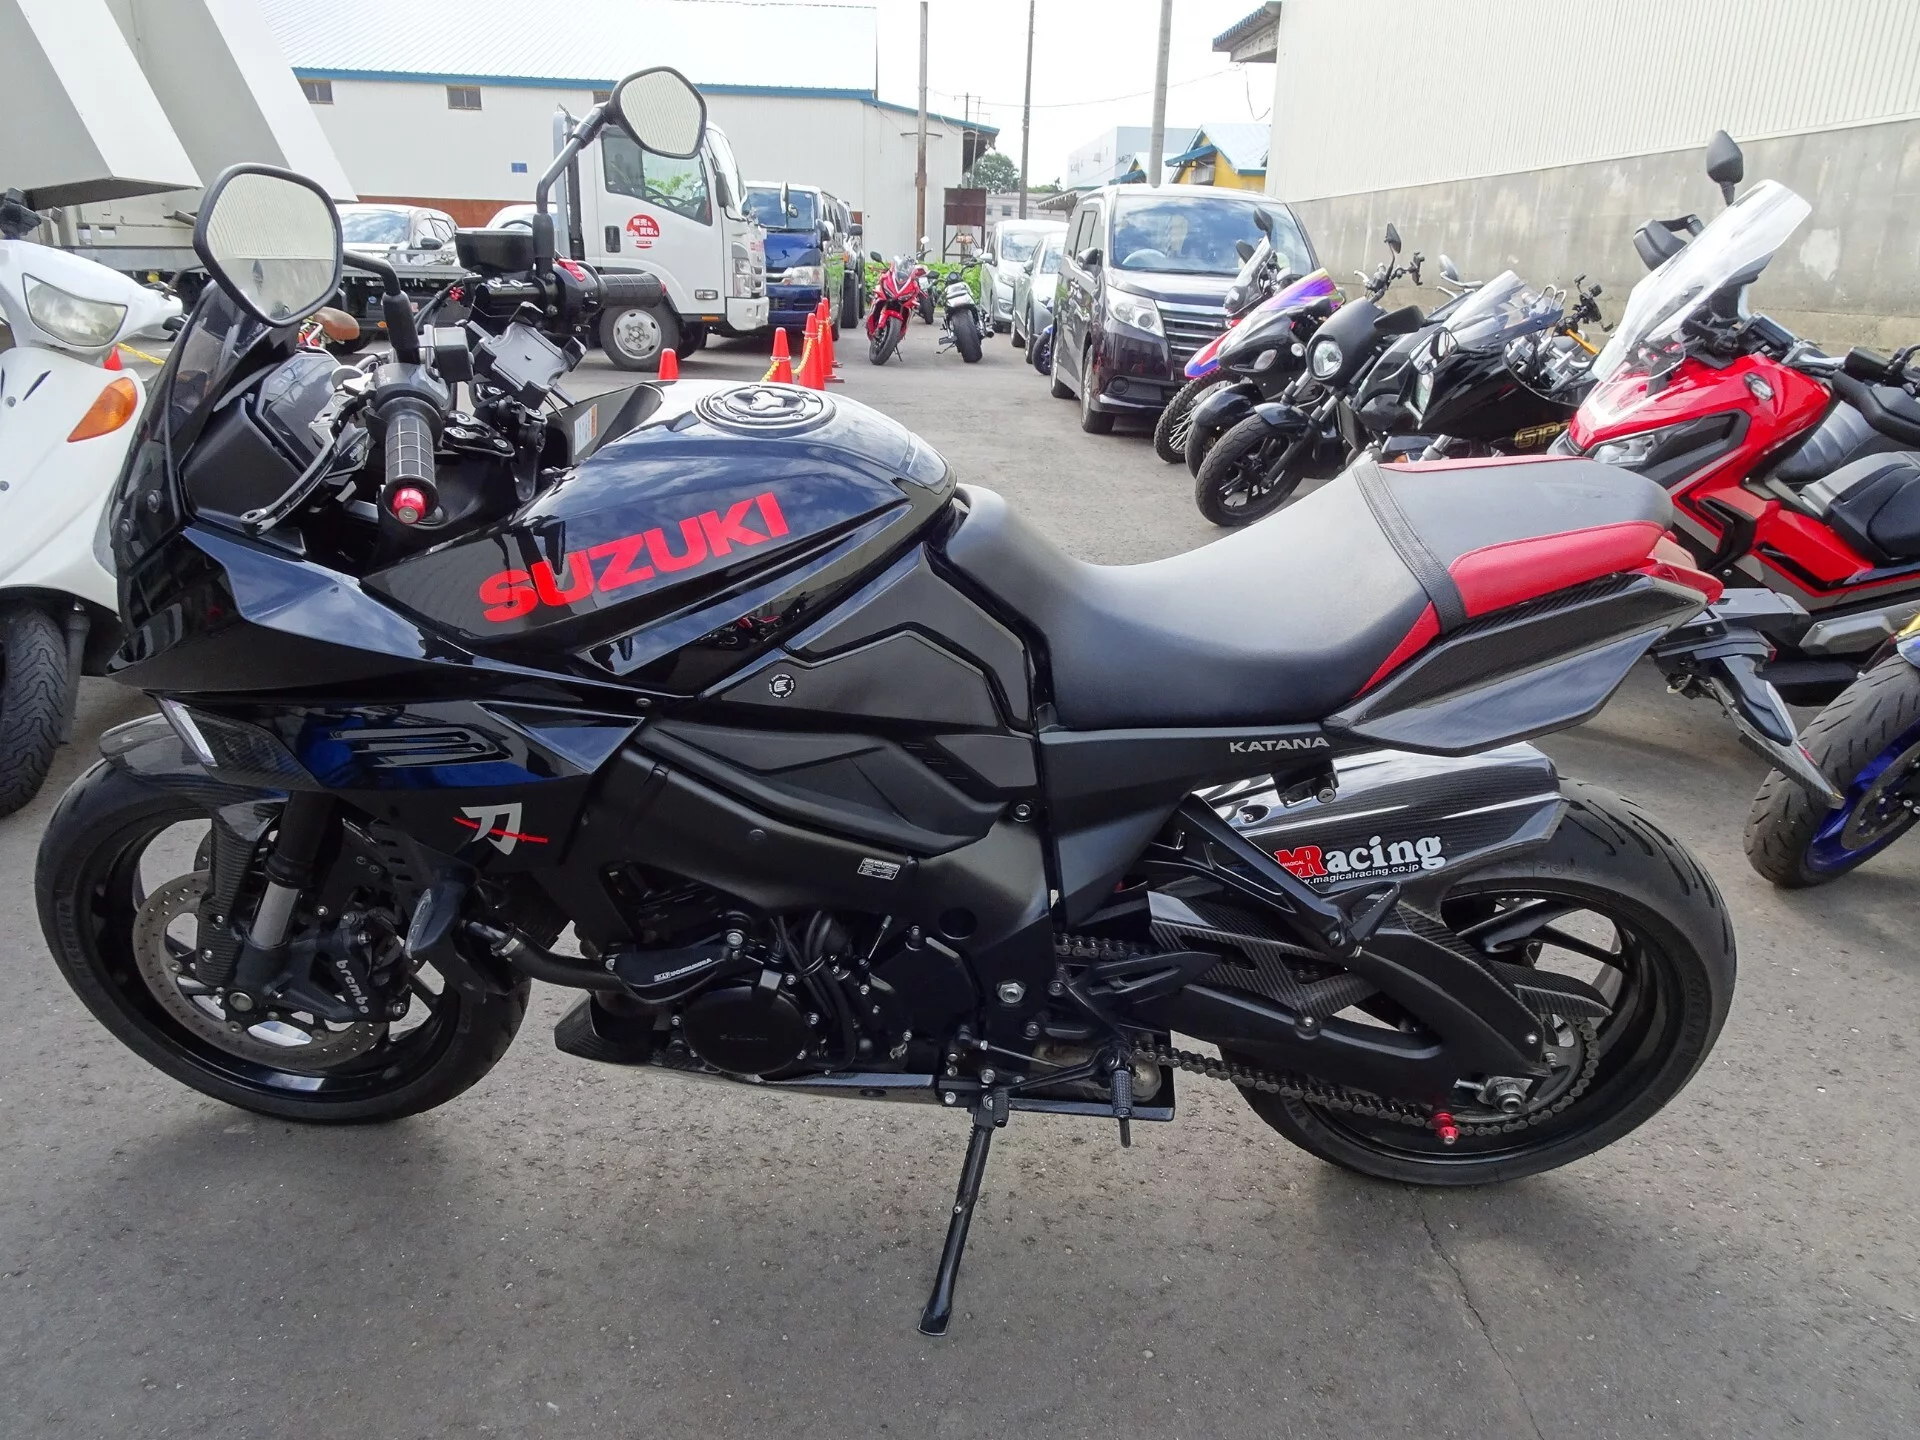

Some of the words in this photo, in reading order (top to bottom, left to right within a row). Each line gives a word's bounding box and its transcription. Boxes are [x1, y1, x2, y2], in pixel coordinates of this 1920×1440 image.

[1515, 420, 1568, 448] GP
[479, 491, 790, 622] SUZUKI
[1229, 736, 1330, 753] KATANA
[460, 802, 522, 855] 刀
[336, 959, 370, 1014] brembo
